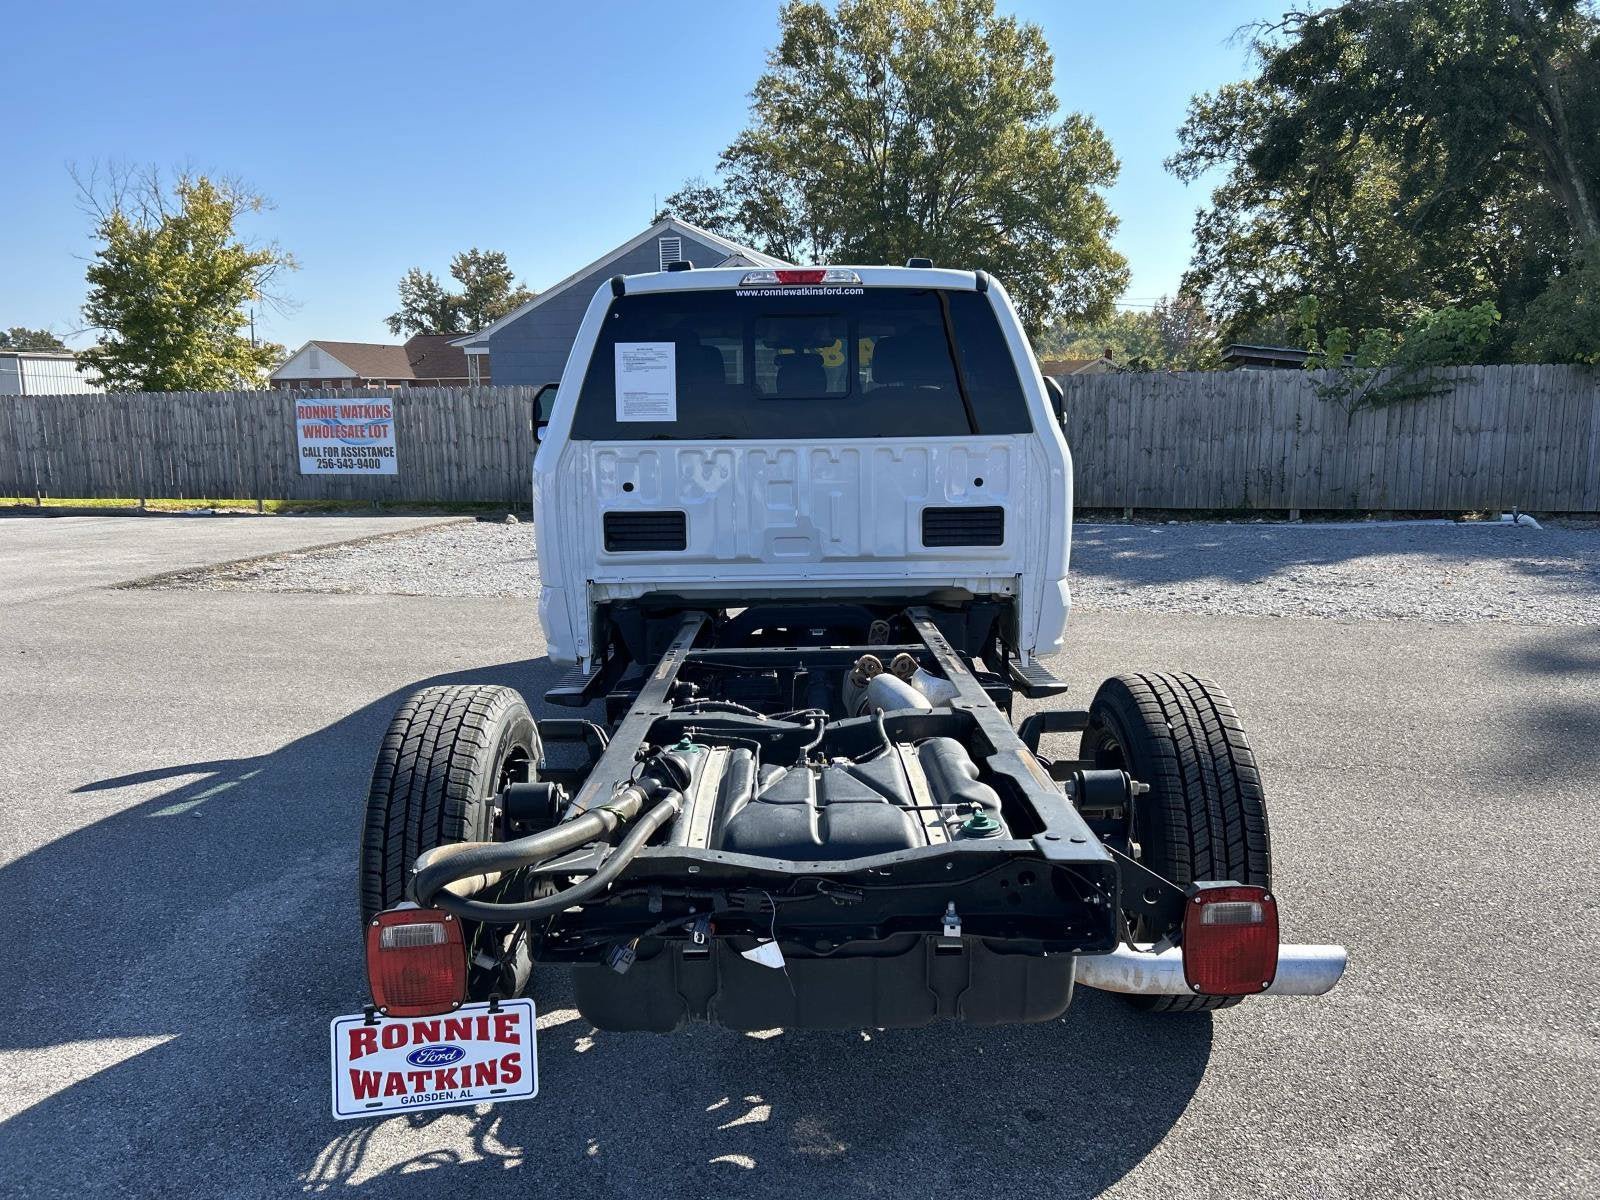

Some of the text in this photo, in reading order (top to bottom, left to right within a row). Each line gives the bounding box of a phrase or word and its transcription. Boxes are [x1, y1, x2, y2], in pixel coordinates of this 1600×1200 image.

[735, 287, 864, 297] www.ronniewatkinsford.com
[297, 404, 392, 419] RONNIE WATKINS
[303, 424, 388, 438] WHOLESALE LOT
[302, 446, 395, 457] CALL FOR ASSISTANCE
[316, 458, 380, 469] 256-543-9400
[349, 1013, 520, 1061] RONNIE
[416, 1047, 456, 1064] Ford
[349, 1052, 522, 1100] WATKINS
[460, 1089, 474, 1098] AL
